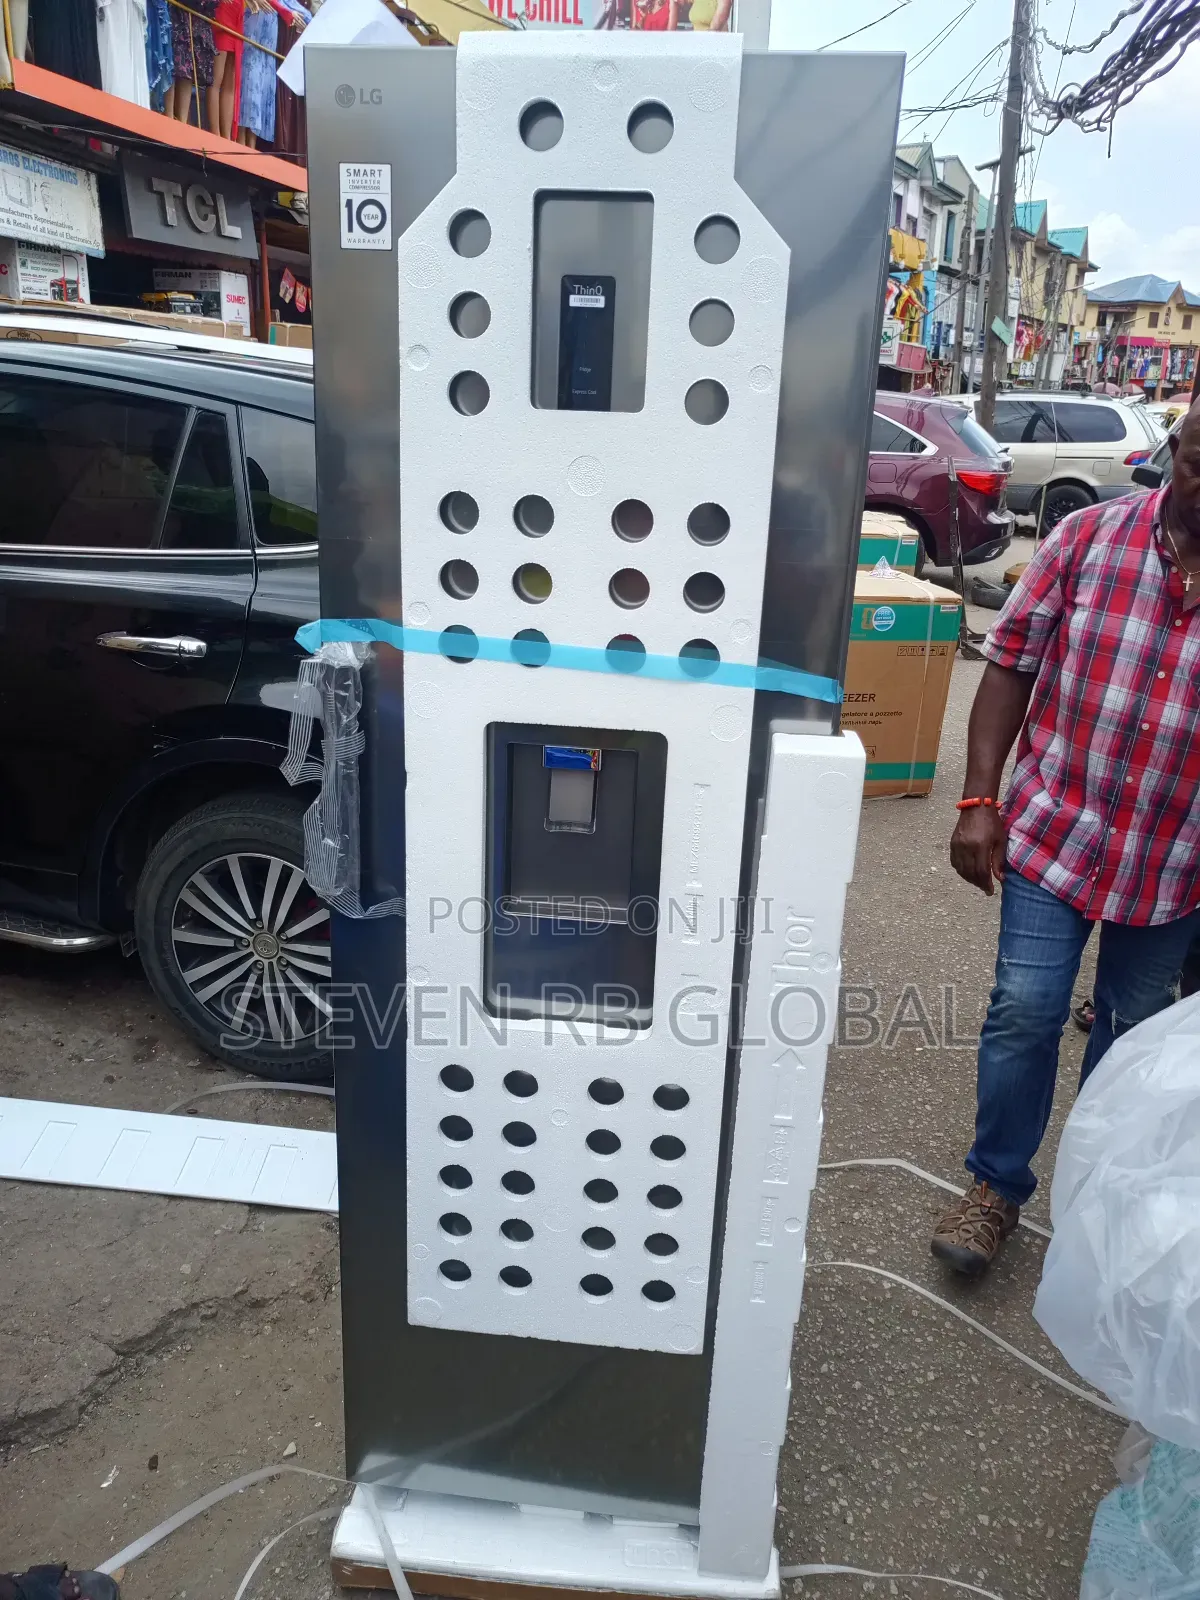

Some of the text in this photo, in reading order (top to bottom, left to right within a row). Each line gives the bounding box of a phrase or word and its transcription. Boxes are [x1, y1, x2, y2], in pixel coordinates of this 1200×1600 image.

[359, 88, 383, 105] LG
[22, 156, 78, 185] ELECTRONICS
[346, 168, 383, 178] SMART
[152, 177, 242, 240] TCL
[345, 198, 387, 234] 10 YEAR
[34, 214, 73, 231] Representatives
[6, 218, 12, 227] &
[13, 220, 31, 231] Retails
[32, 224, 39, 233] of
[46, 227, 58, 237] kind
[59, 231, 65, 239] of
[65, 233, 92, 246] Electronics
[17, 240, 61, 255] FIRMAN
[346, 237, 386, 245] WARRANTY
[155, 271, 192, 279] FIRMAN
[573, 284, 603, 296] ThinQ
[226, 293, 246, 305] SUMEC
